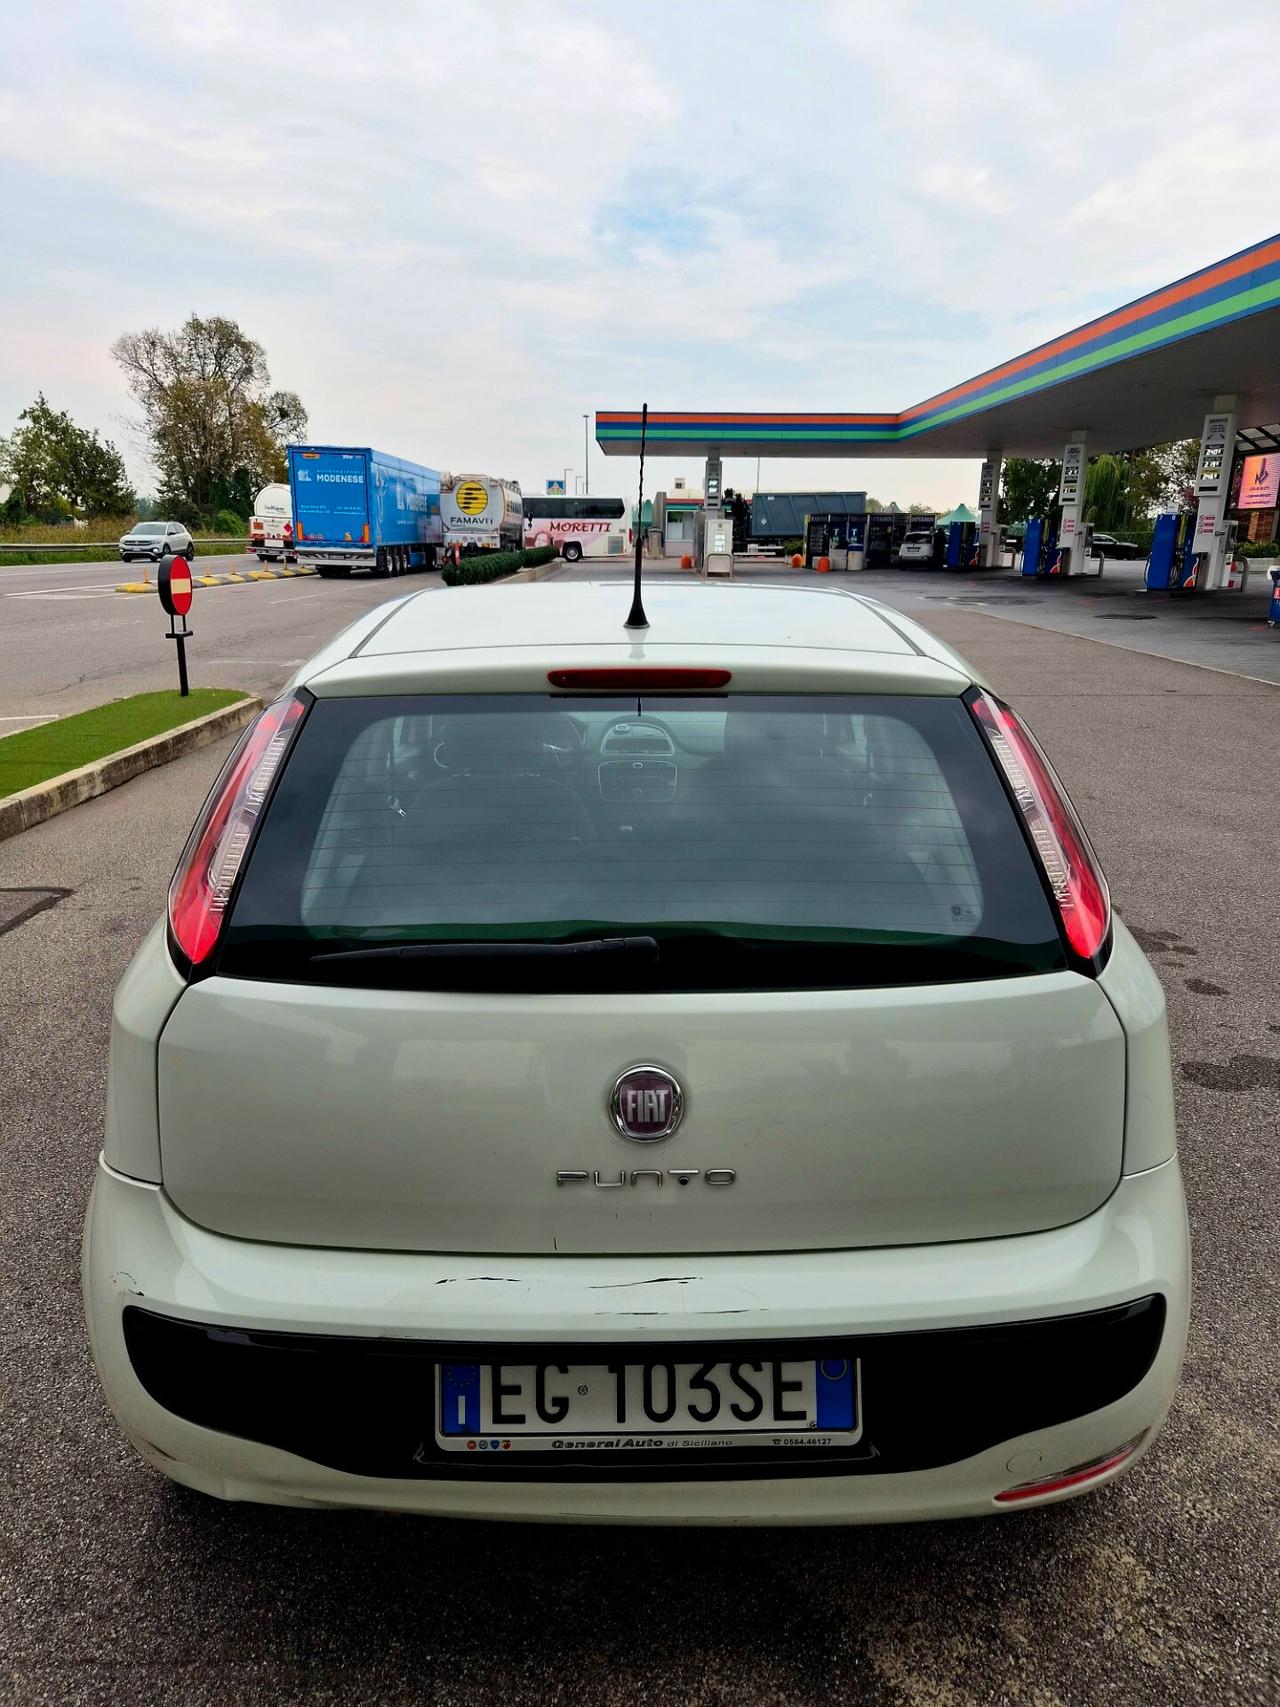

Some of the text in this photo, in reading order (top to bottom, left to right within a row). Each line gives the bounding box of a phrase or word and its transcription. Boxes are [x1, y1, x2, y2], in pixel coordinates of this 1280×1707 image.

[316, 474, 364, 484] MODENESE
[550, 521, 612, 533] MORETTI
[627, 1089, 670, 1123] FIAT
[556, 1169, 737, 1189] PUNTO
[551, 1437, 733, 1449] General Auto di Siciliano
[783, 1437, 832, 1445] 0584.46127
